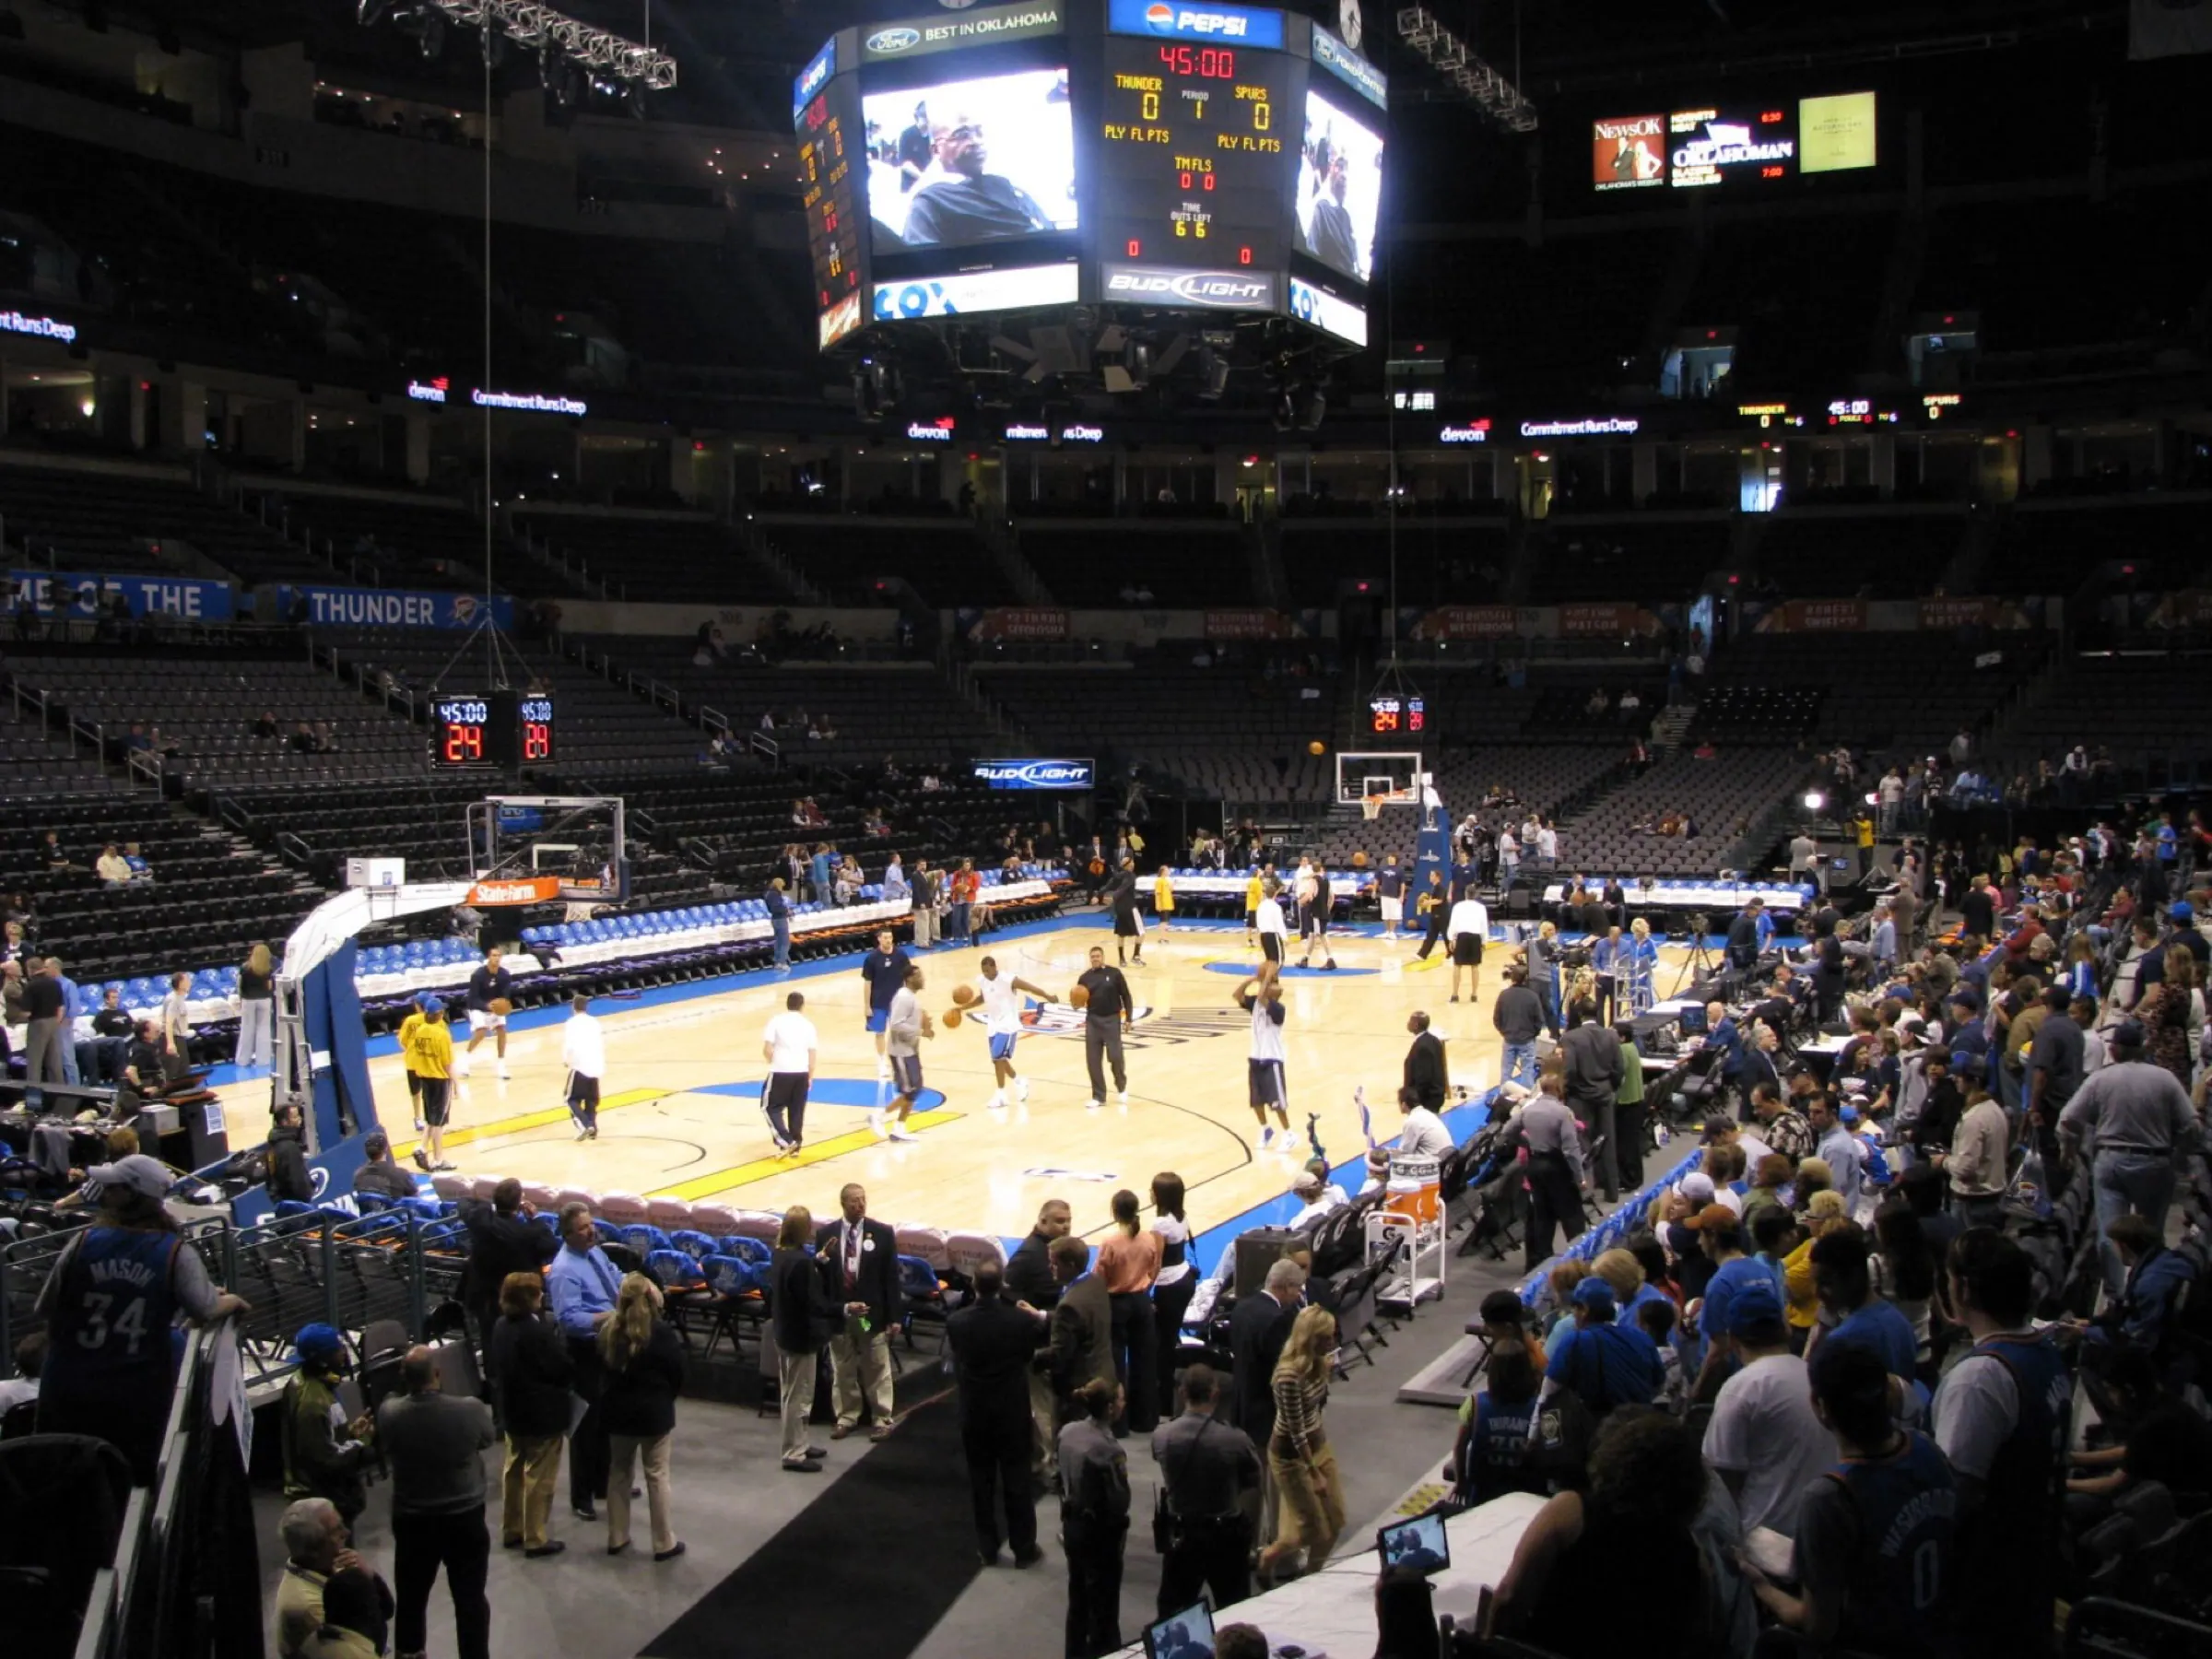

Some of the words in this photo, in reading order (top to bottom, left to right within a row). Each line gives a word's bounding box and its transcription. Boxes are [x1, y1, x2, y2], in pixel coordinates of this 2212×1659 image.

[925, 26, 956, 41] BEST
[959, 22, 974, 36] IN
[977, 10, 1058, 34] OKLAHOMA
[1178, 12, 1248, 37] PEPSI
[1159, 47, 1233, 78] 45:00
[1114, 75, 1163, 91] THUNDER
[1235, 86, 1267, 100] SPURS
[1142, 93, 1159, 121] 0
[1254, 102, 1271, 130] 0
[1104, 124, 1126, 139] PLY
[1131, 127, 1145, 142] FL
[1147, 128, 1170, 144] PTS
[1217, 135, 1239, 150] PLY
[1243, 137, 1257, 151] FL
[1258, 138, 1281, 153] PTS
[1182, 173, 1191, 189] 0
[1205, 175, 1214, 190] 0
[1108, 276, 1171, 293] BUD
[1184, 277, 1267, 298] LIGHT
[874, 282, 959, 321] COX
[41, 317, 76, 344] Deep
[407, 380, 445, 402] devon
[559, 397, 587, 416] Deep
[908, 421, 950, 440] devon
[1440, 426, 1486, 442] devon
[1609, 418, 1639, 435] Deep
[141, 582, 202, 618] THE
[312, 593, 435, 626] THUNDER
[441, 701, 488, 724] 45:00
[522, 700, 552, 722] 45:00
[447, 724, 481, 761] 24
[1028, 767, 1089, 780] LIGHT
[89, 1258, 157, 1288] MASON
[76, 1291, 148, 1355] 34
[1912, 1537, 1940, 1610] 0
